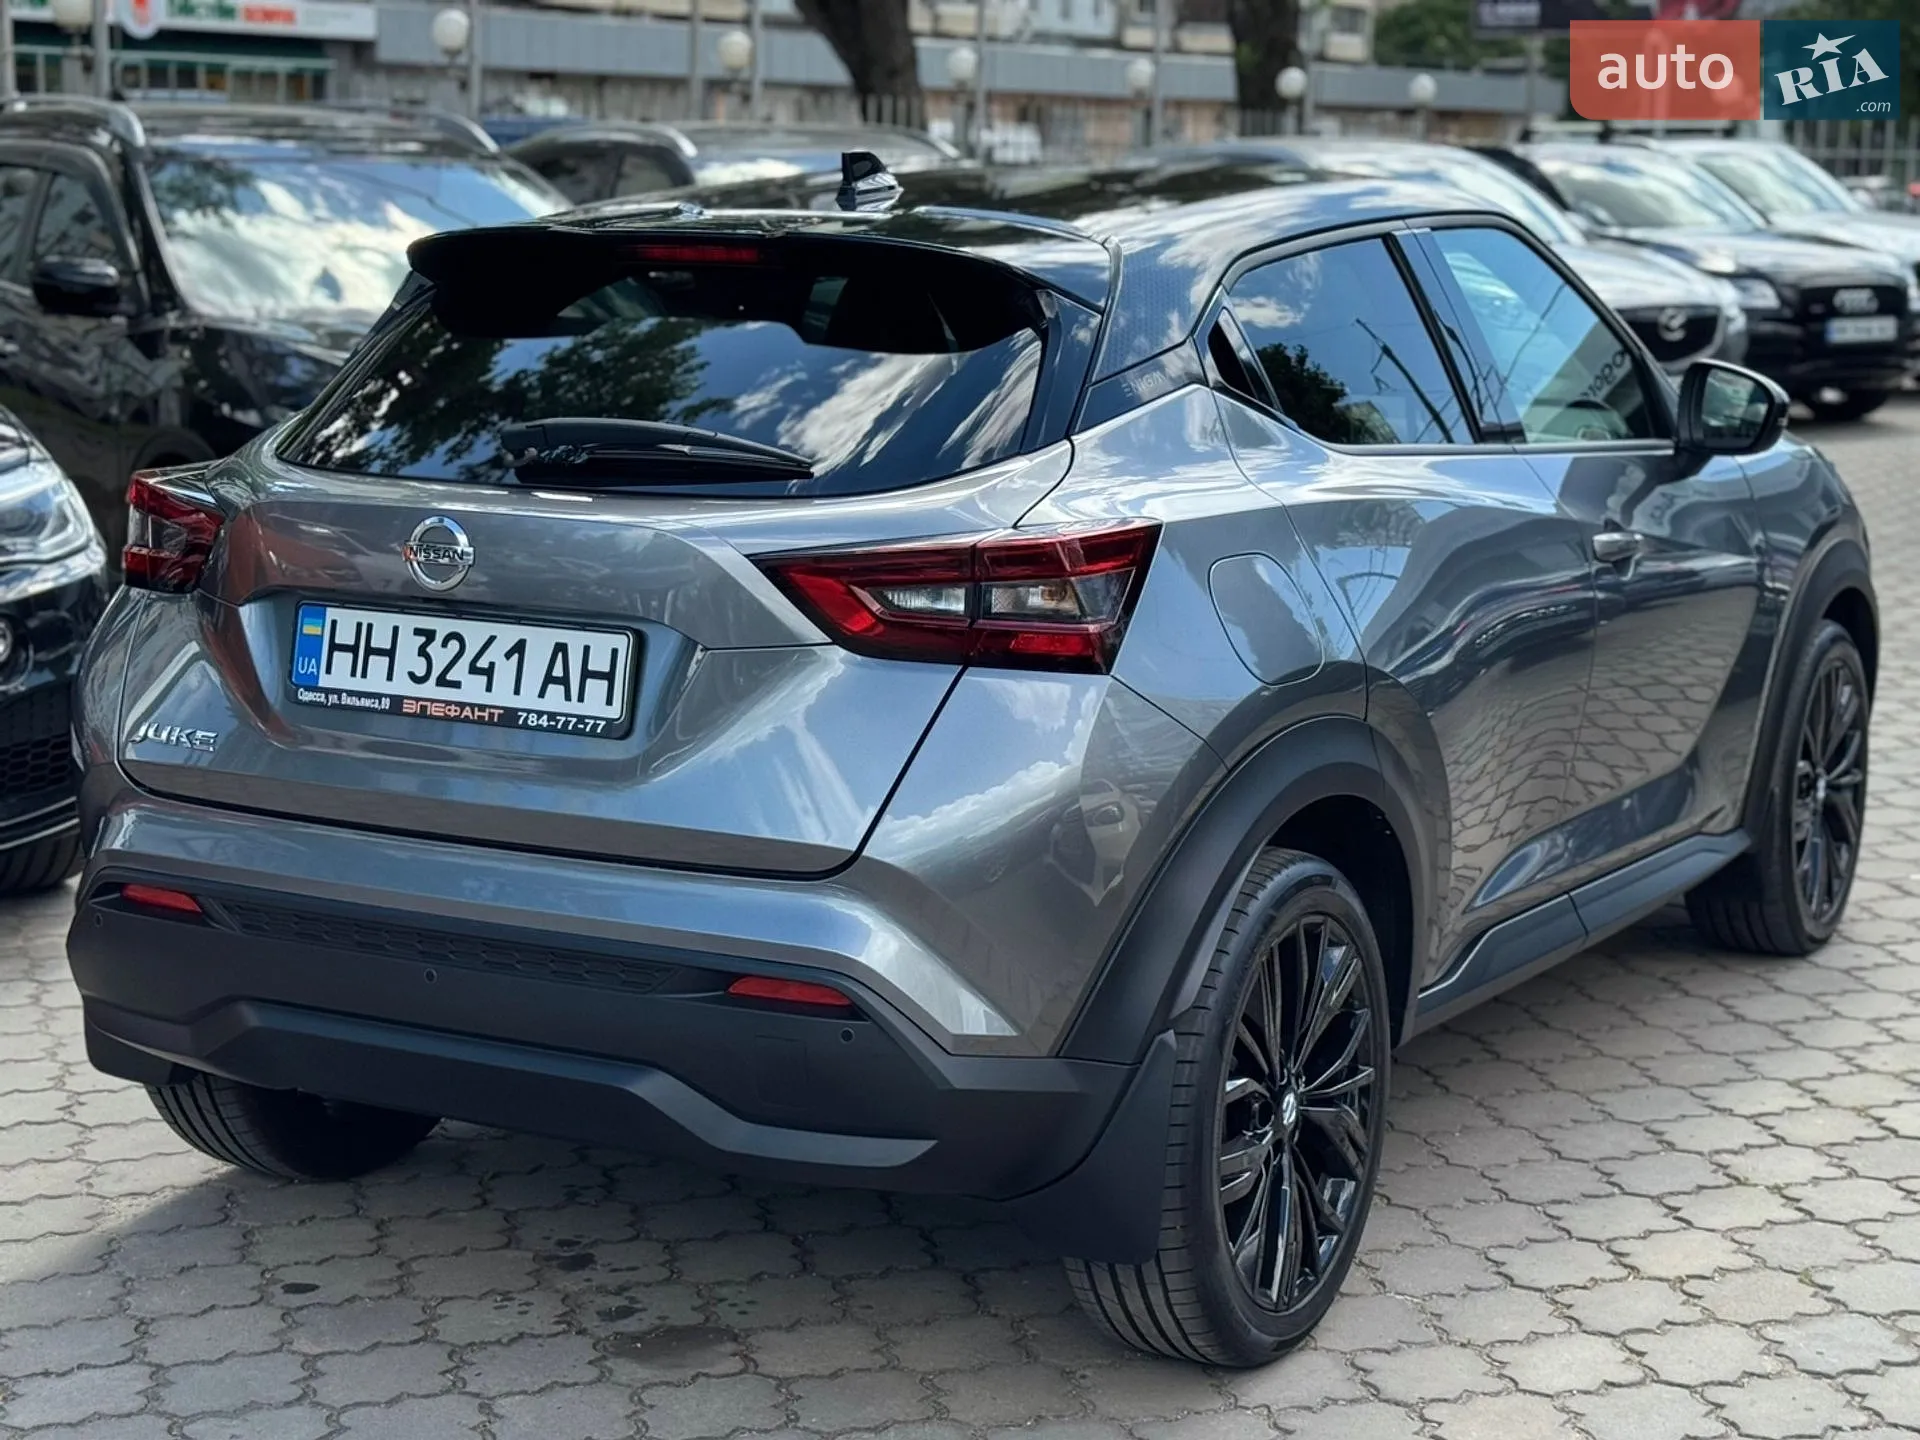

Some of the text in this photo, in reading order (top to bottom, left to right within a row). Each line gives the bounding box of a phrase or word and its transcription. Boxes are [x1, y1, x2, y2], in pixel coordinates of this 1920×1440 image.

[409, 545, 464, 561] NISSAN
[297, 656, 318, 676] UA
[324, 619, 619, 706] HH 3241 AH
[517, 711, 607, 734] 784-77-77
[128, 721, 218, 752] JUKE
